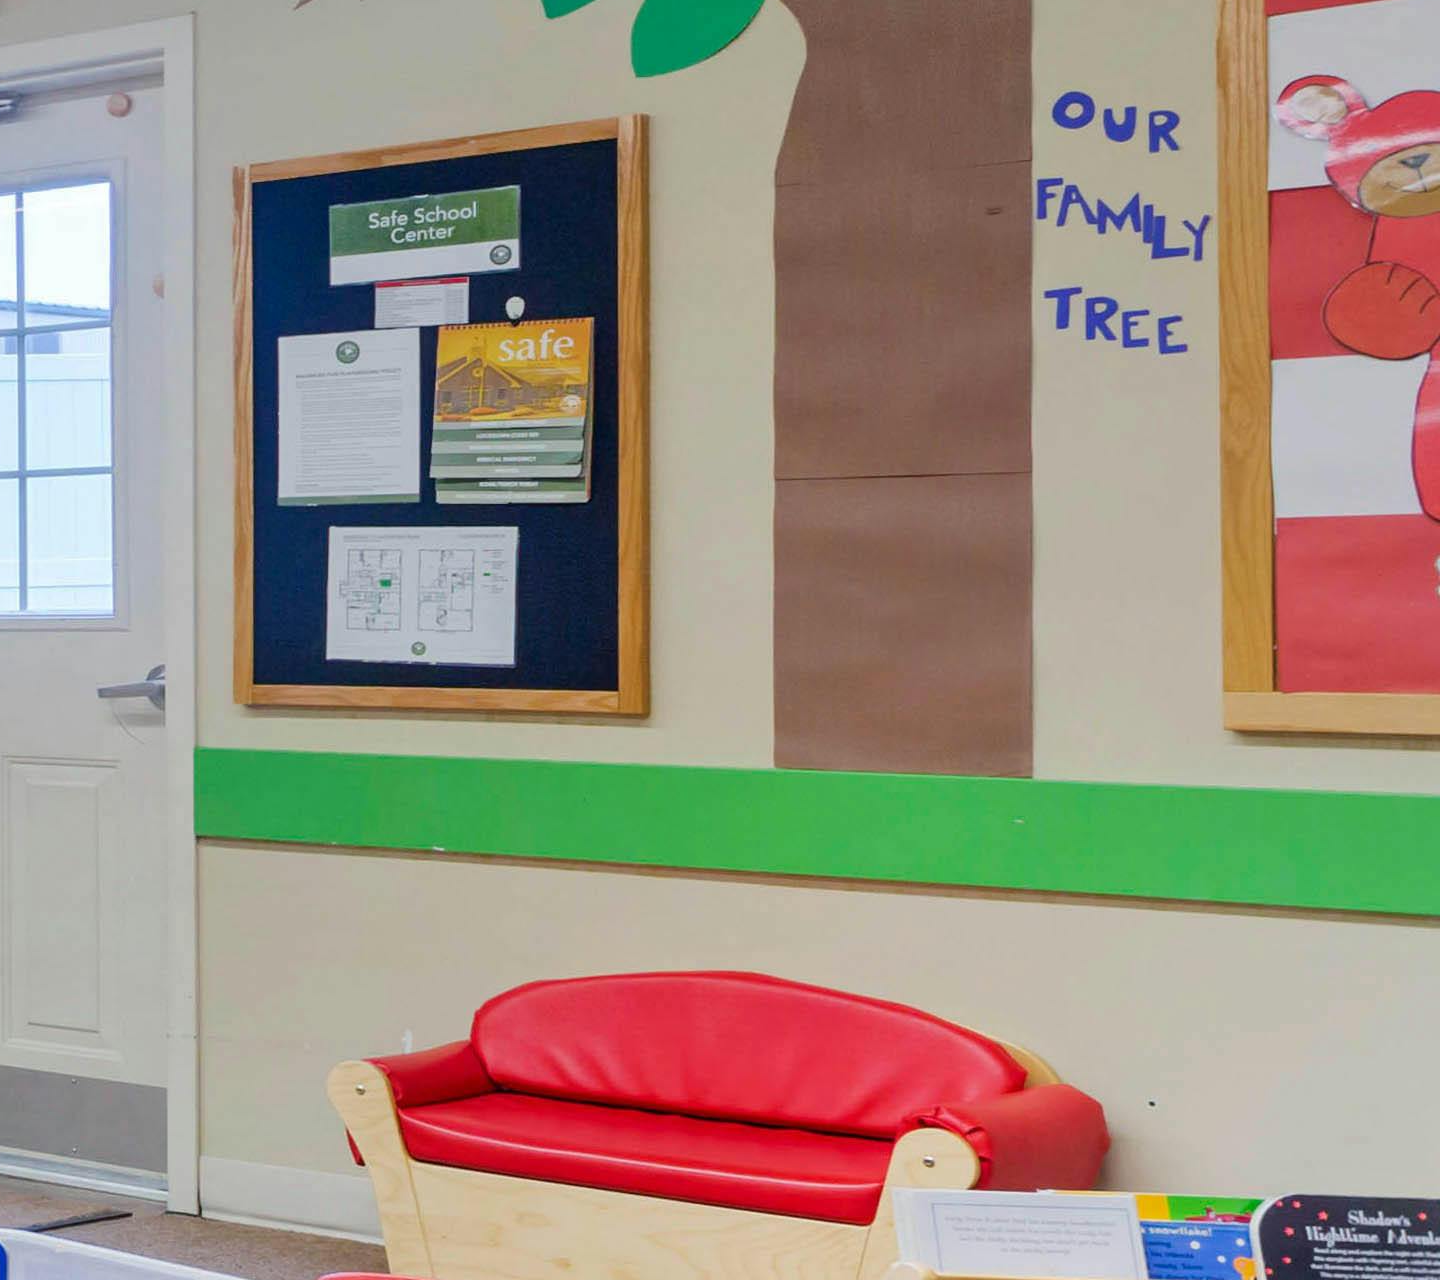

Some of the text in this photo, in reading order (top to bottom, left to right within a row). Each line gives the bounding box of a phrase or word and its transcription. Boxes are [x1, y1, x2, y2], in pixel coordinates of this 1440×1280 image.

[1051, 91, 1181, 152] OUR
[368, 201, 478, 229] Safe School
[1035, 176, 1212, 262] FAMILY
[390, 225, 455, 245] Center
[1044, 285, 1189, 355] TREE
[498, 329, 575, 362] safe
[1347, 1209, 1412, 1227] Shadow's
